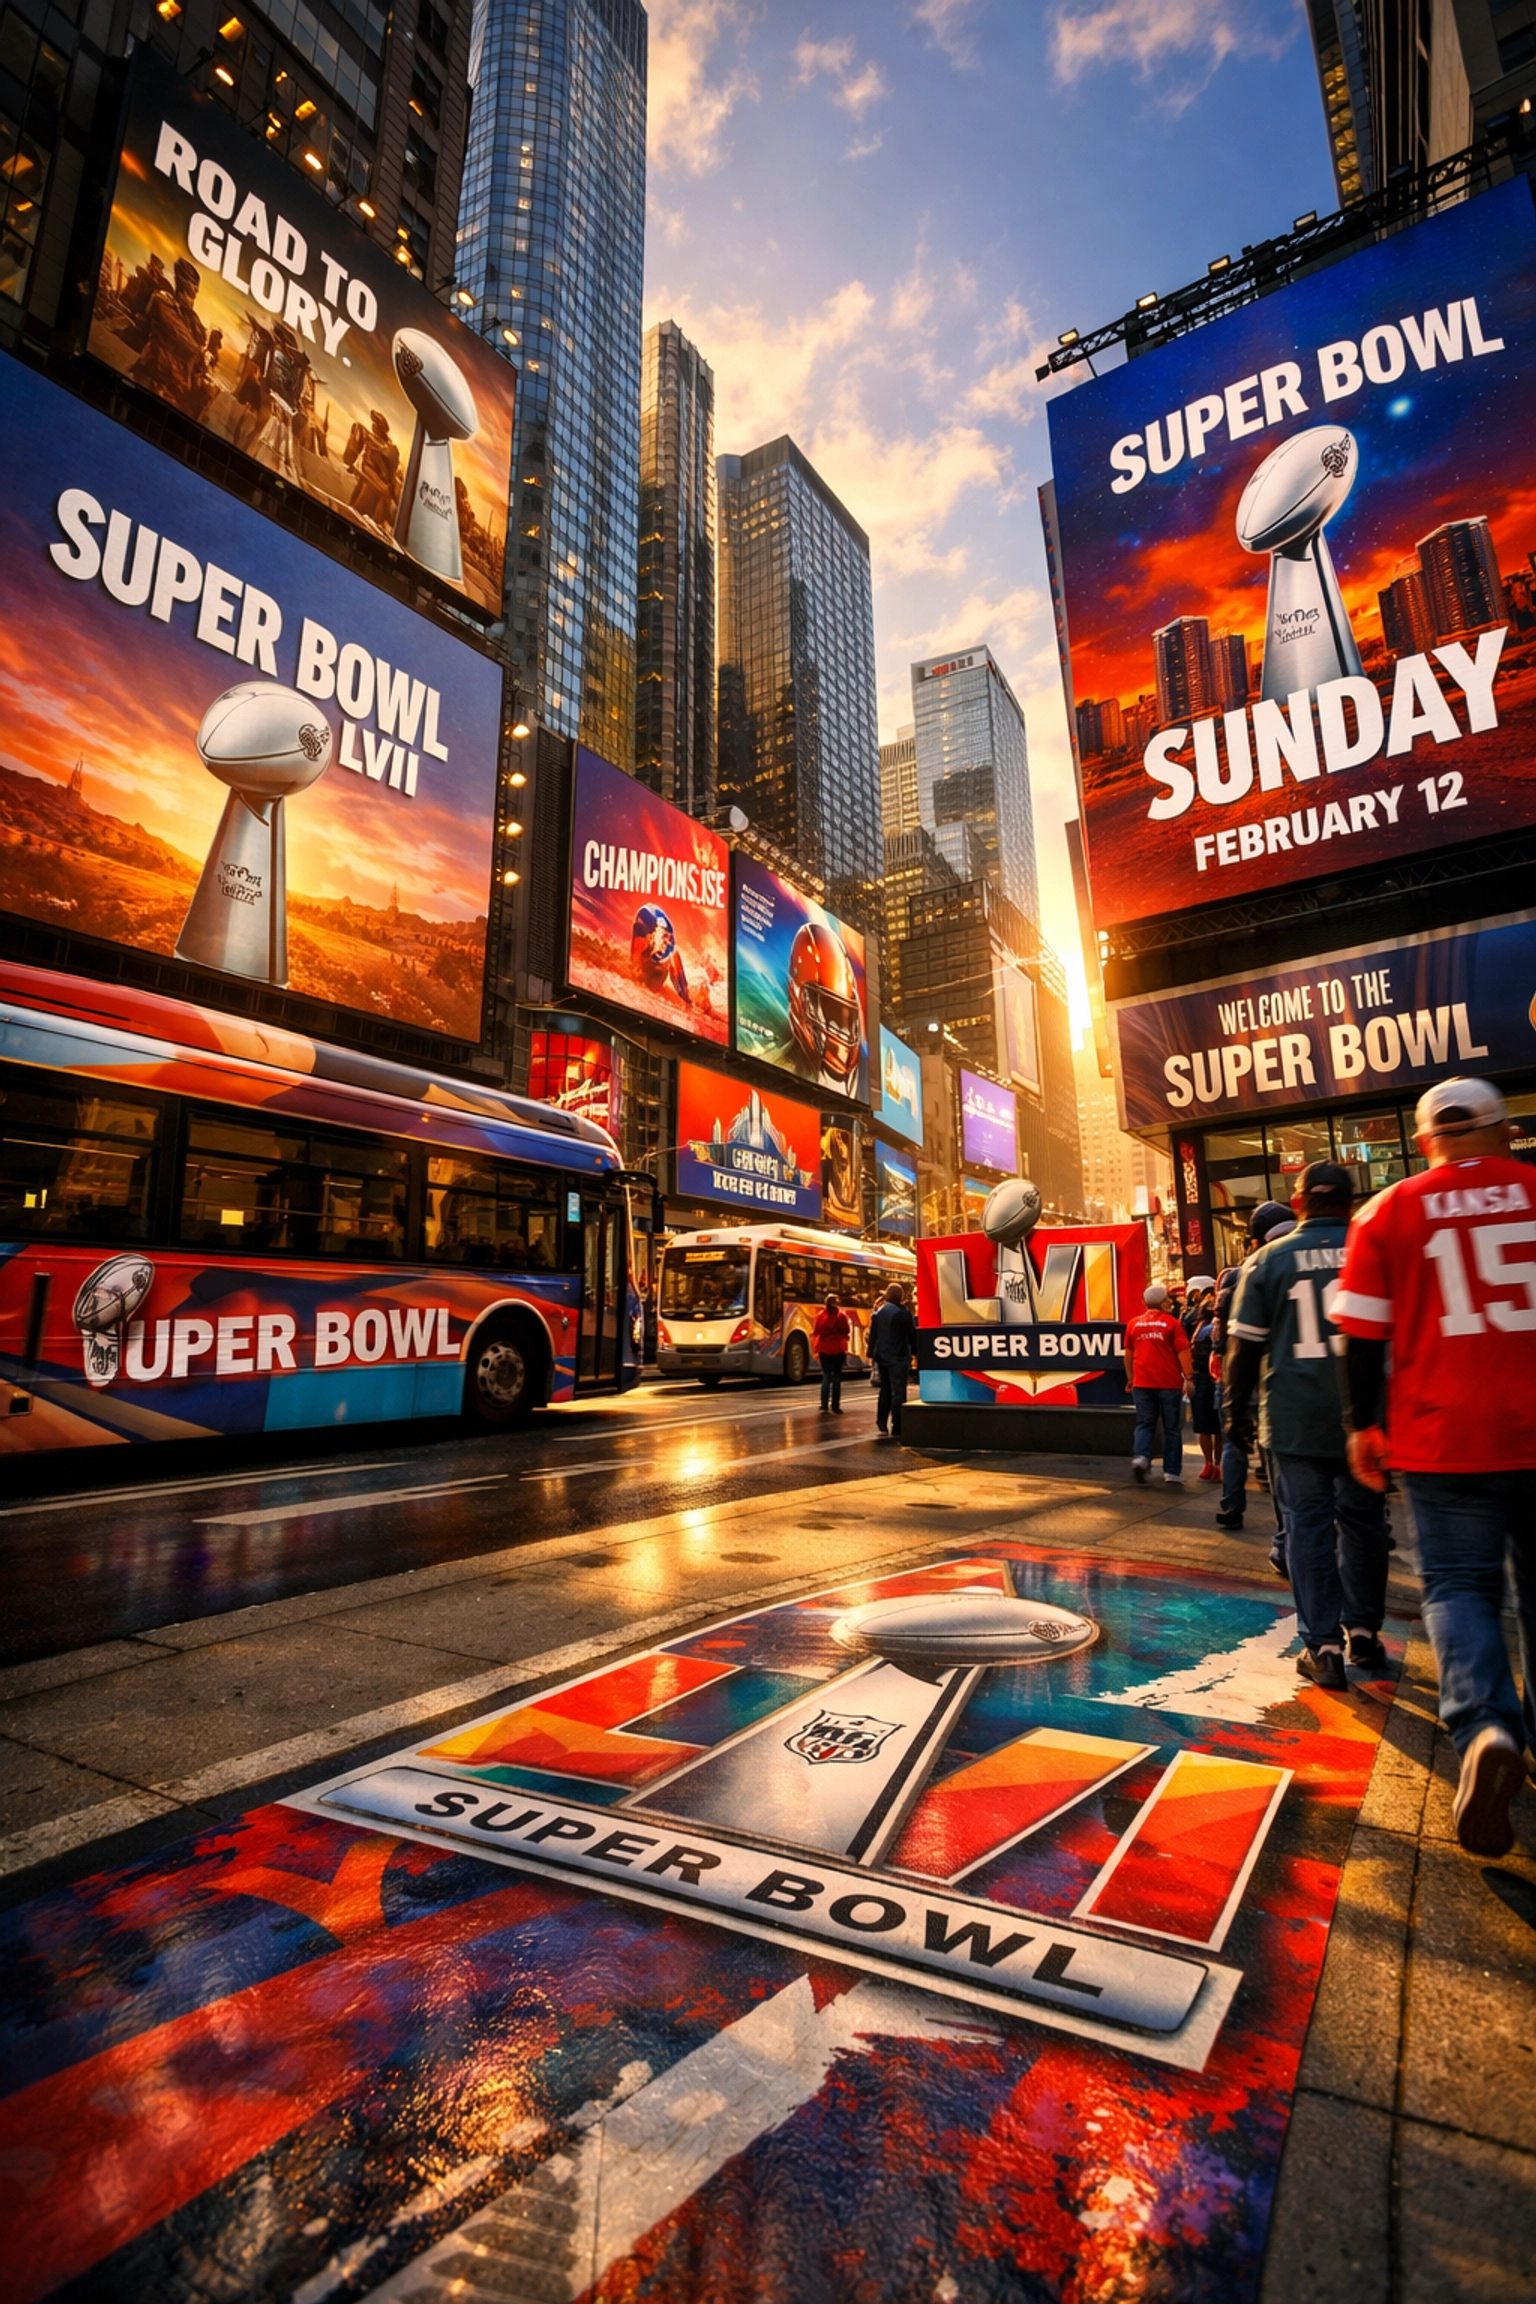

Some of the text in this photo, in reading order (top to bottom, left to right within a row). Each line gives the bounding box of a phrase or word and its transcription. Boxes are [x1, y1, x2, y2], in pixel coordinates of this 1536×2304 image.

[154, 120, 379, 335] ROAD TO
[187, 212, 353, 368] GLORY.
[1109, 296, 1505, 495] SUPER BOWL
[49, 488, 449, 764] SUPER BOWL
[339, 718, 420, 799] LVII
[1142, 626, 1509, 822] SUNDAY
[1193, 770, 1468, 872] FEBRUARY 12
[1163, 1001, 1490, 1109] SUPER BOWL
[1217, 968, 1394, 1036] WELCOME TO THE
[315, 1307, 461, 1367] BOWL
[933, 1333, 1126, 1359] SUPER BOWL
[415, 1790, 1105, 1999] SUPER BOWL
